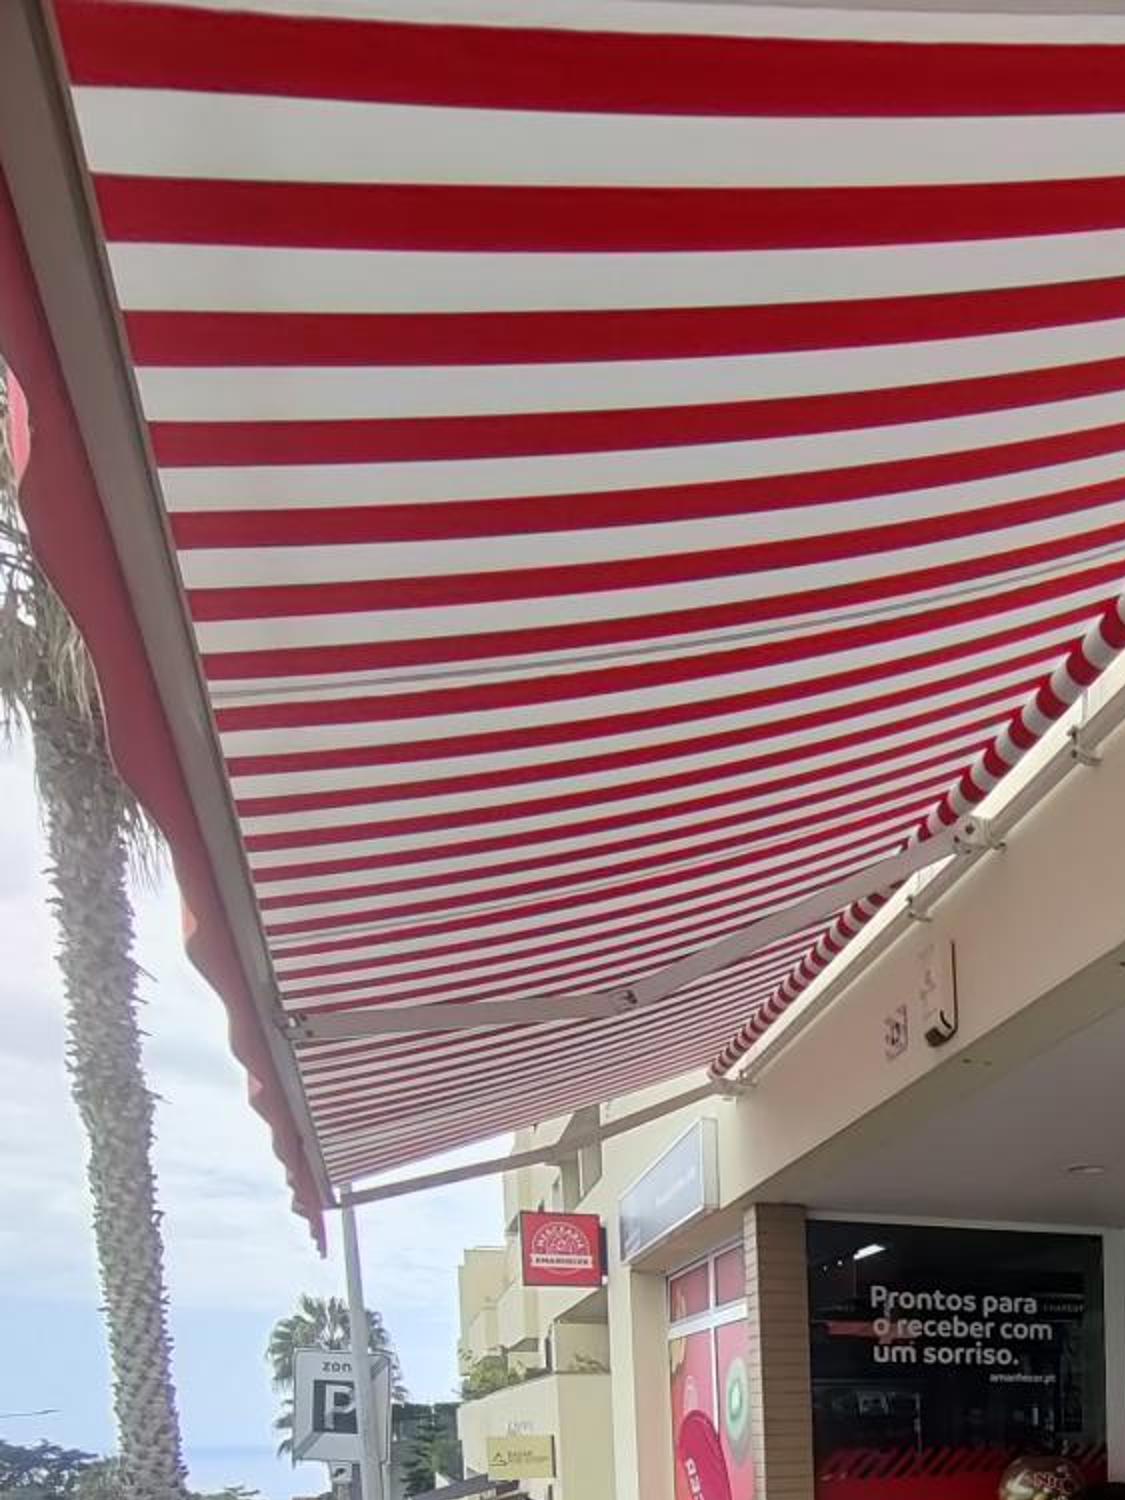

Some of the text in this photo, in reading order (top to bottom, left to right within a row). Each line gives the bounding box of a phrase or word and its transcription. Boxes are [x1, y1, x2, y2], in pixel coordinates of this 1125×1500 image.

[870, 1285, 976, 1311] Prontos
[982, 1295, 1037, 1318] para
[873, 1315, 1053, 1340] o receber com
[873, 1341, 1019, 1365] um sorriso.
[321, 1361, 353, 1373] zon
